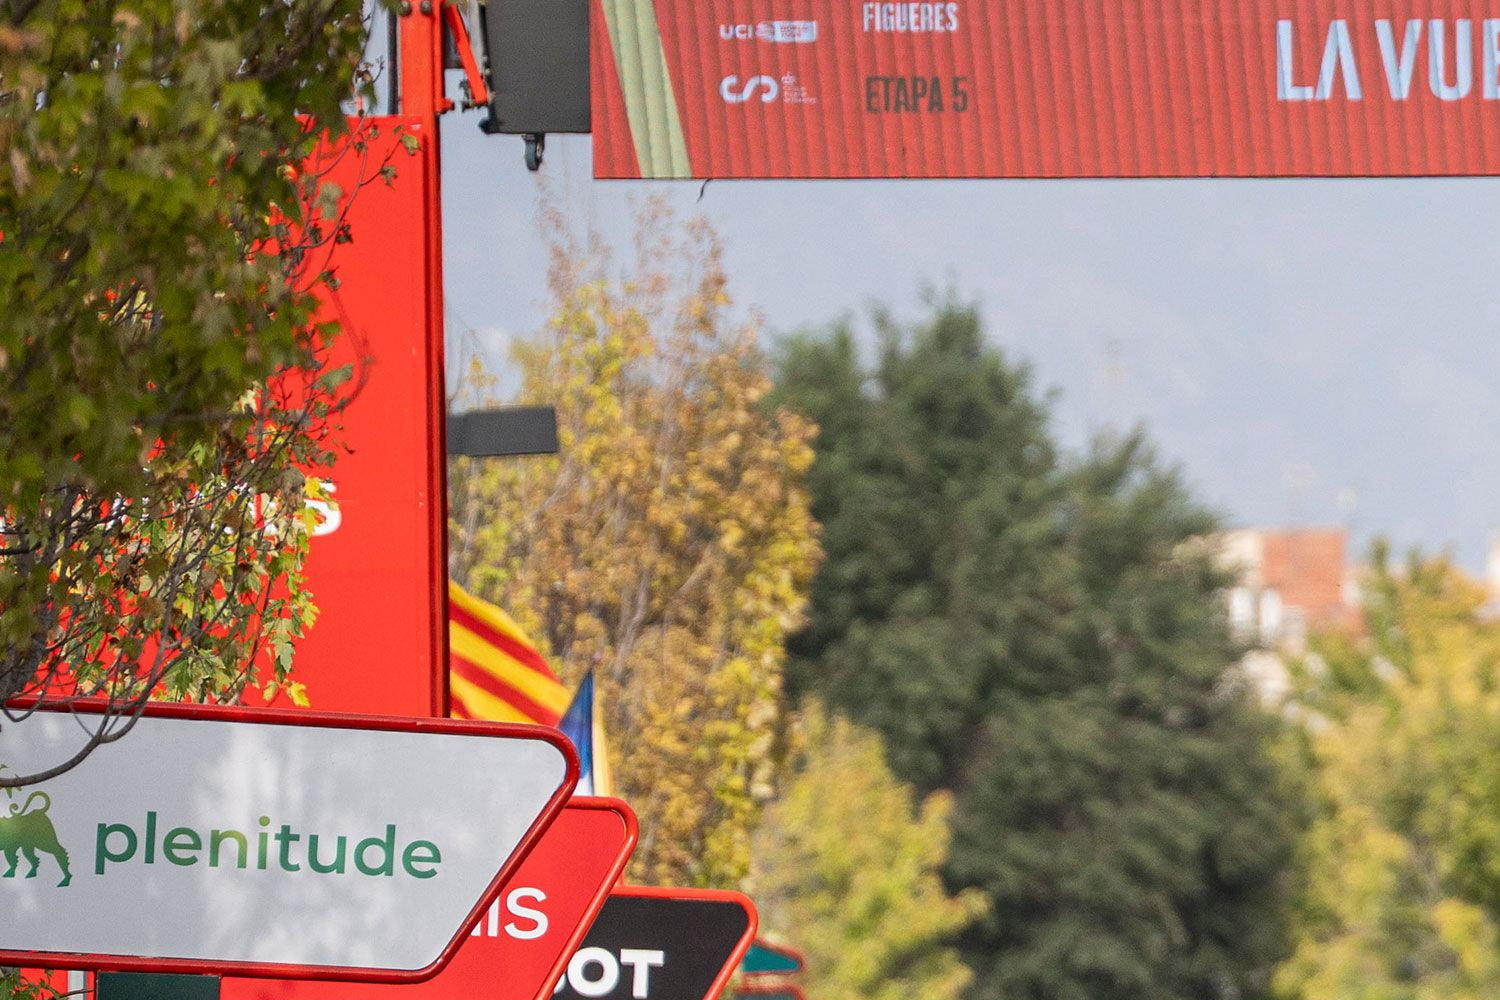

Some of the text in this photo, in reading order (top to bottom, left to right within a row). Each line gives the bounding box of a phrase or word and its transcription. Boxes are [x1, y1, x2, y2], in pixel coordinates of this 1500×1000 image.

[863, 2, 958, 32] FIGUERES
[1276, 19, 1362, 100] LA
[866, 77, 968, 113] ETAPA 5
[95, 811, 442, 879] plenitude
